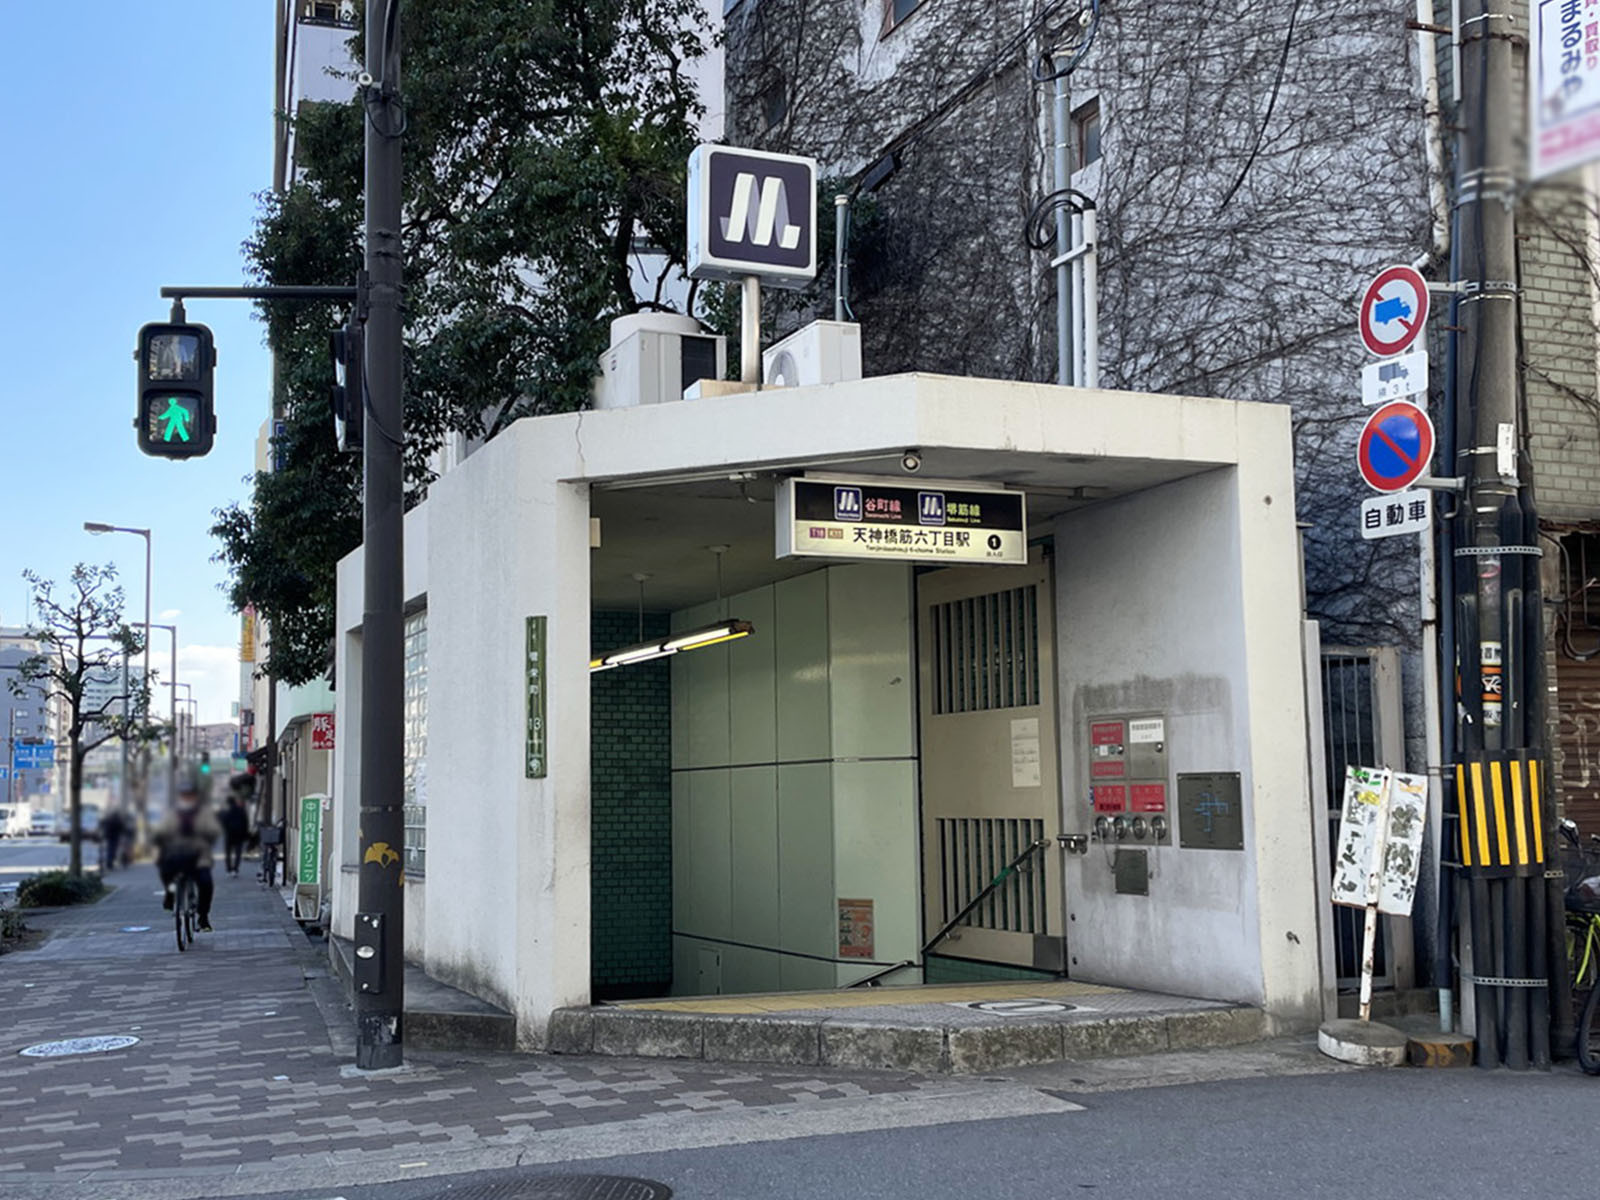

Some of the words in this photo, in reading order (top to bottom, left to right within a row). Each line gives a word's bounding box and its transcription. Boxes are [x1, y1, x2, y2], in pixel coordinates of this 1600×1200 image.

[865, 497, 901, 512] 谷町線
[946, 502, 981, 517] 堺筋線
[1365, 499, 1426, 529] 自動車
[853, 527, 970, 548] 天神橋筋六丁目駅
